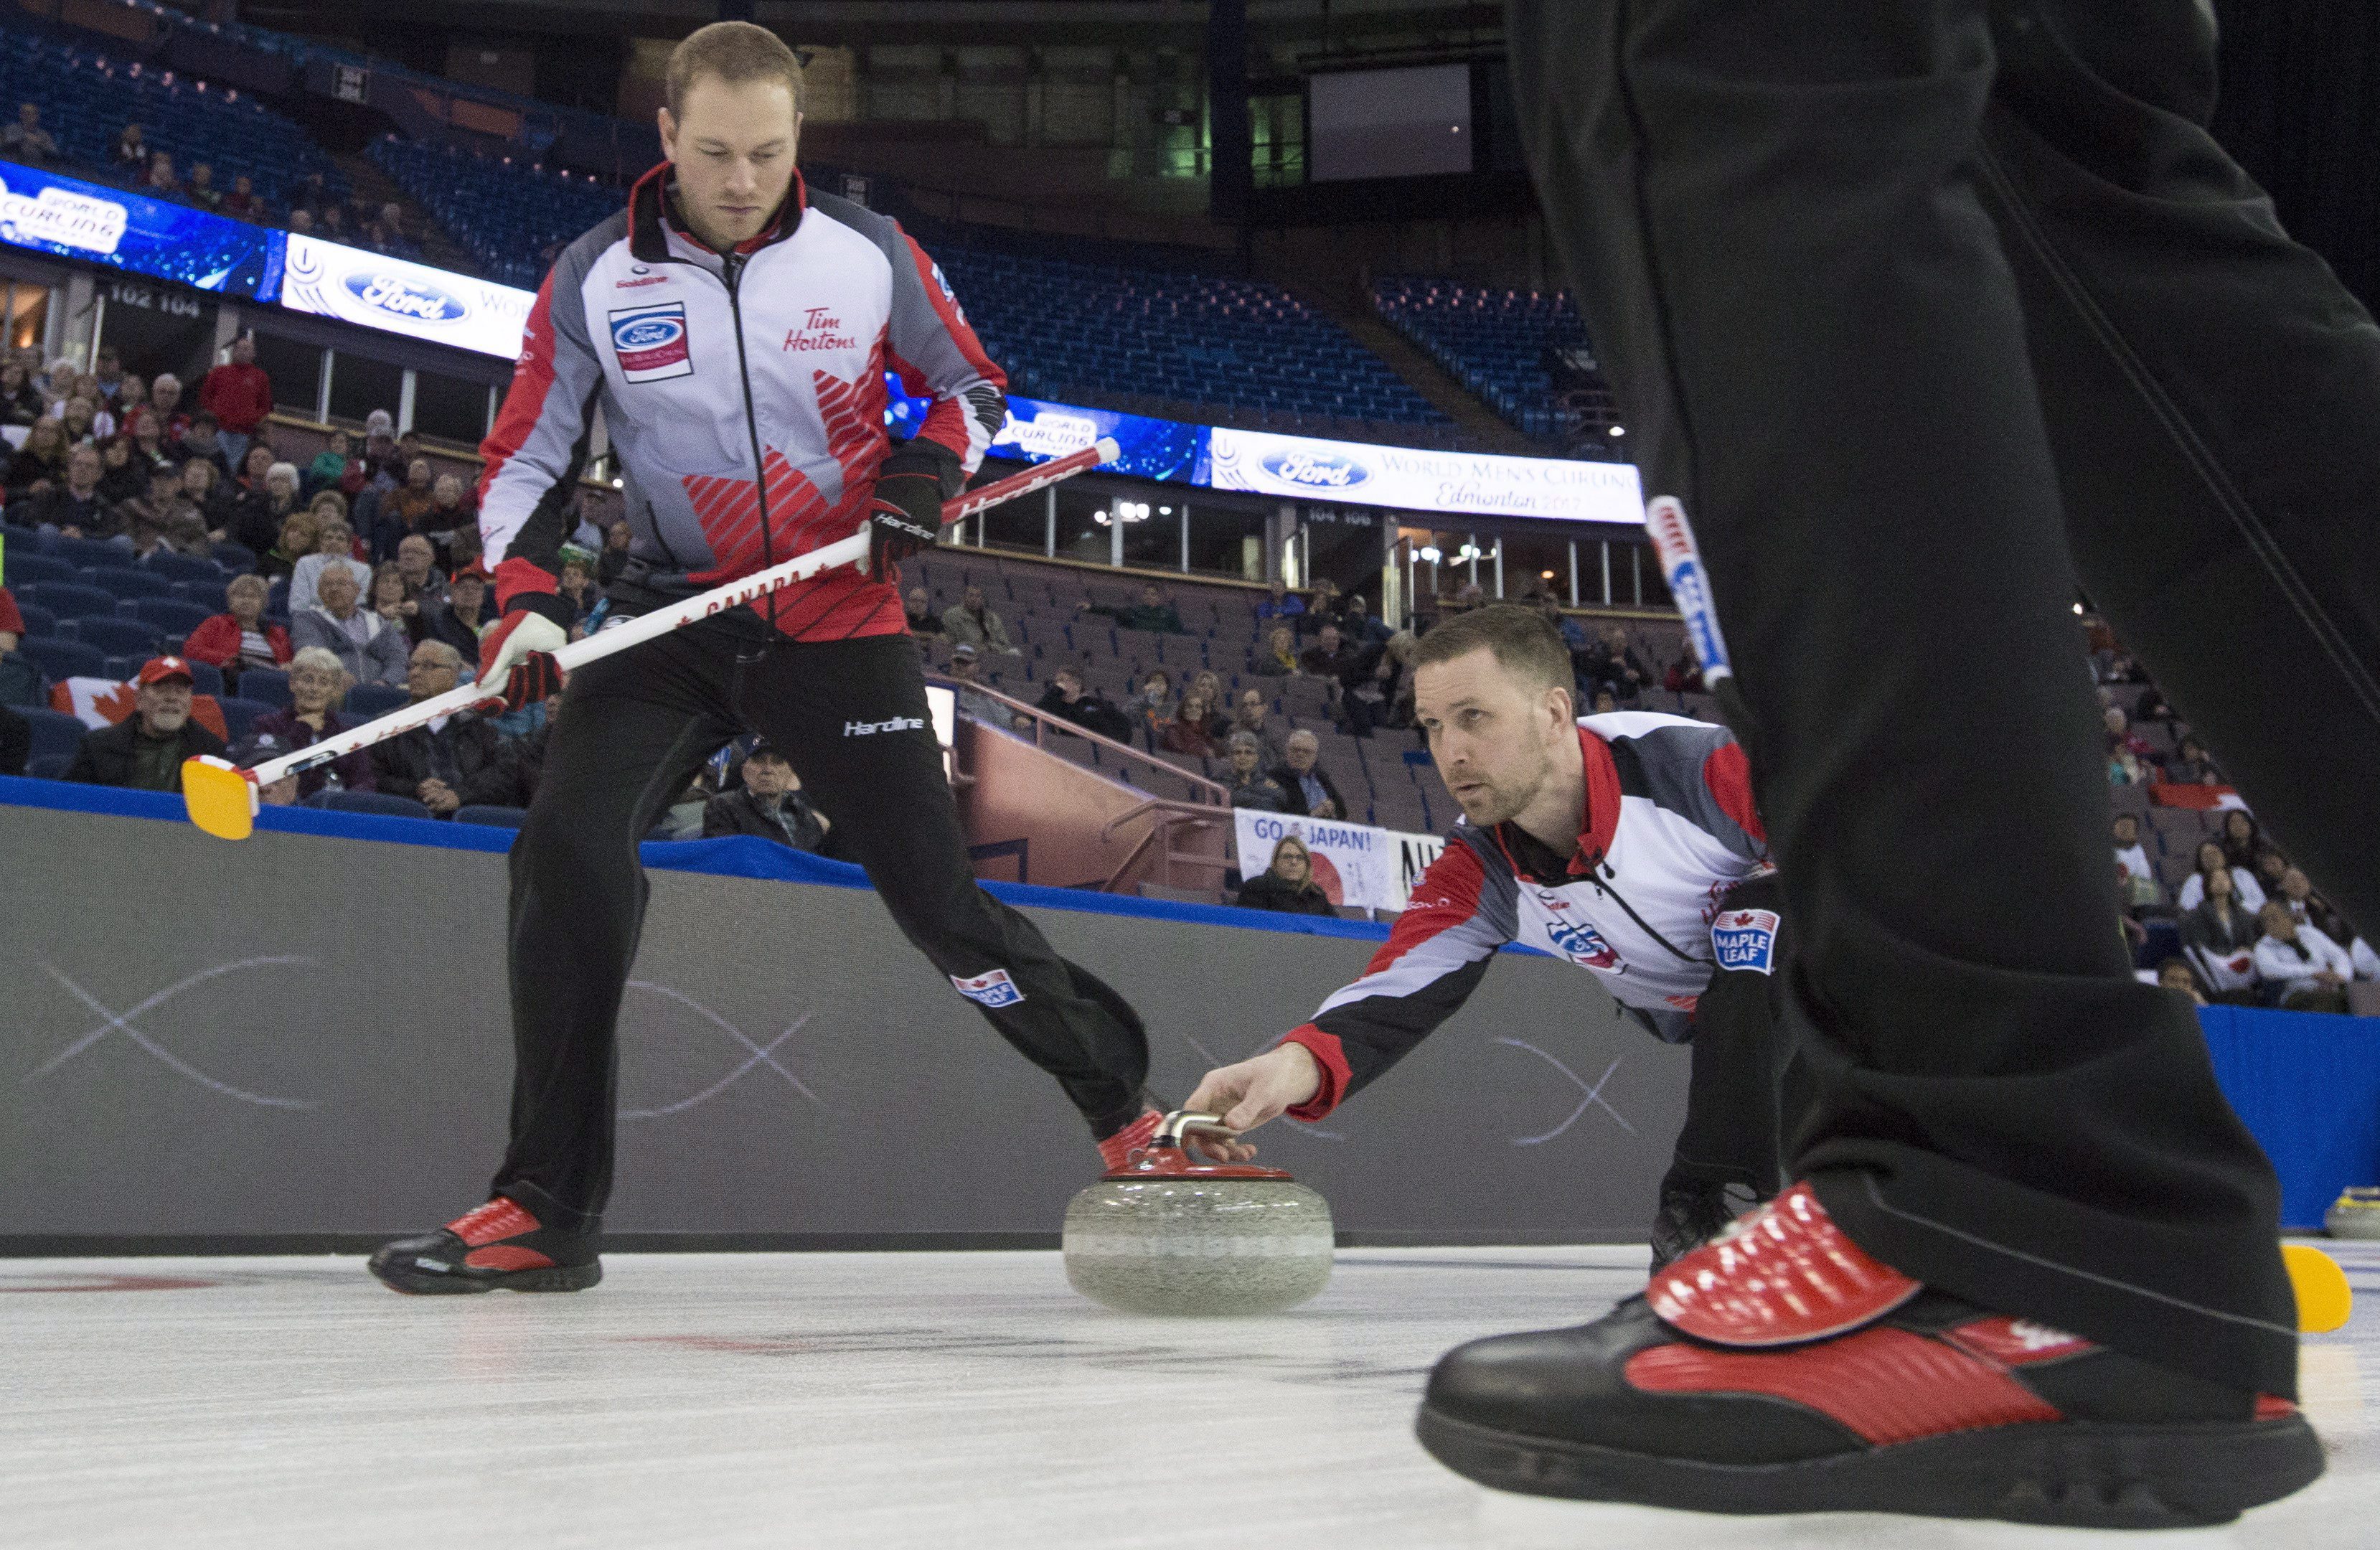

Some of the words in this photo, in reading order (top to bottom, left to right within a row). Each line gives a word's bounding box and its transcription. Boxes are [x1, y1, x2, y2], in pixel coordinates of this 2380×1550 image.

[3, 201, 114, 238] CURLING
[46, 194, 119, 221] WORLD
[112, 285, 152, 309] 102
[160, 294, 200, 317] 104
[362, 274, 448, 320] Ford
[804, 307, 840, 330] Tim
[629, 325, 667, 343] Ford
[782, 329, 855, 352] Hortons
[1012, 426, 1089, 446] CURLING
[1040, 418, 1091, 433] WORLD
[1279, 453, 1353, 486] Ford
[1381, 453, 1462, 479] WORLD
[1472, 460, 1535, 482] MEN'S
[1436, 481, 1538, 509] Edmonton
[874, 513, 936, 540] Hardline
[843, 716, 925, 736] Hardline
[1255, 819, 1284, 841] GO
[1309, 826, 1372, 852] JAPAN!
[1716, 933, 1768, 950] MAPLE
[1723, 947, 1759, 963] LEAF
